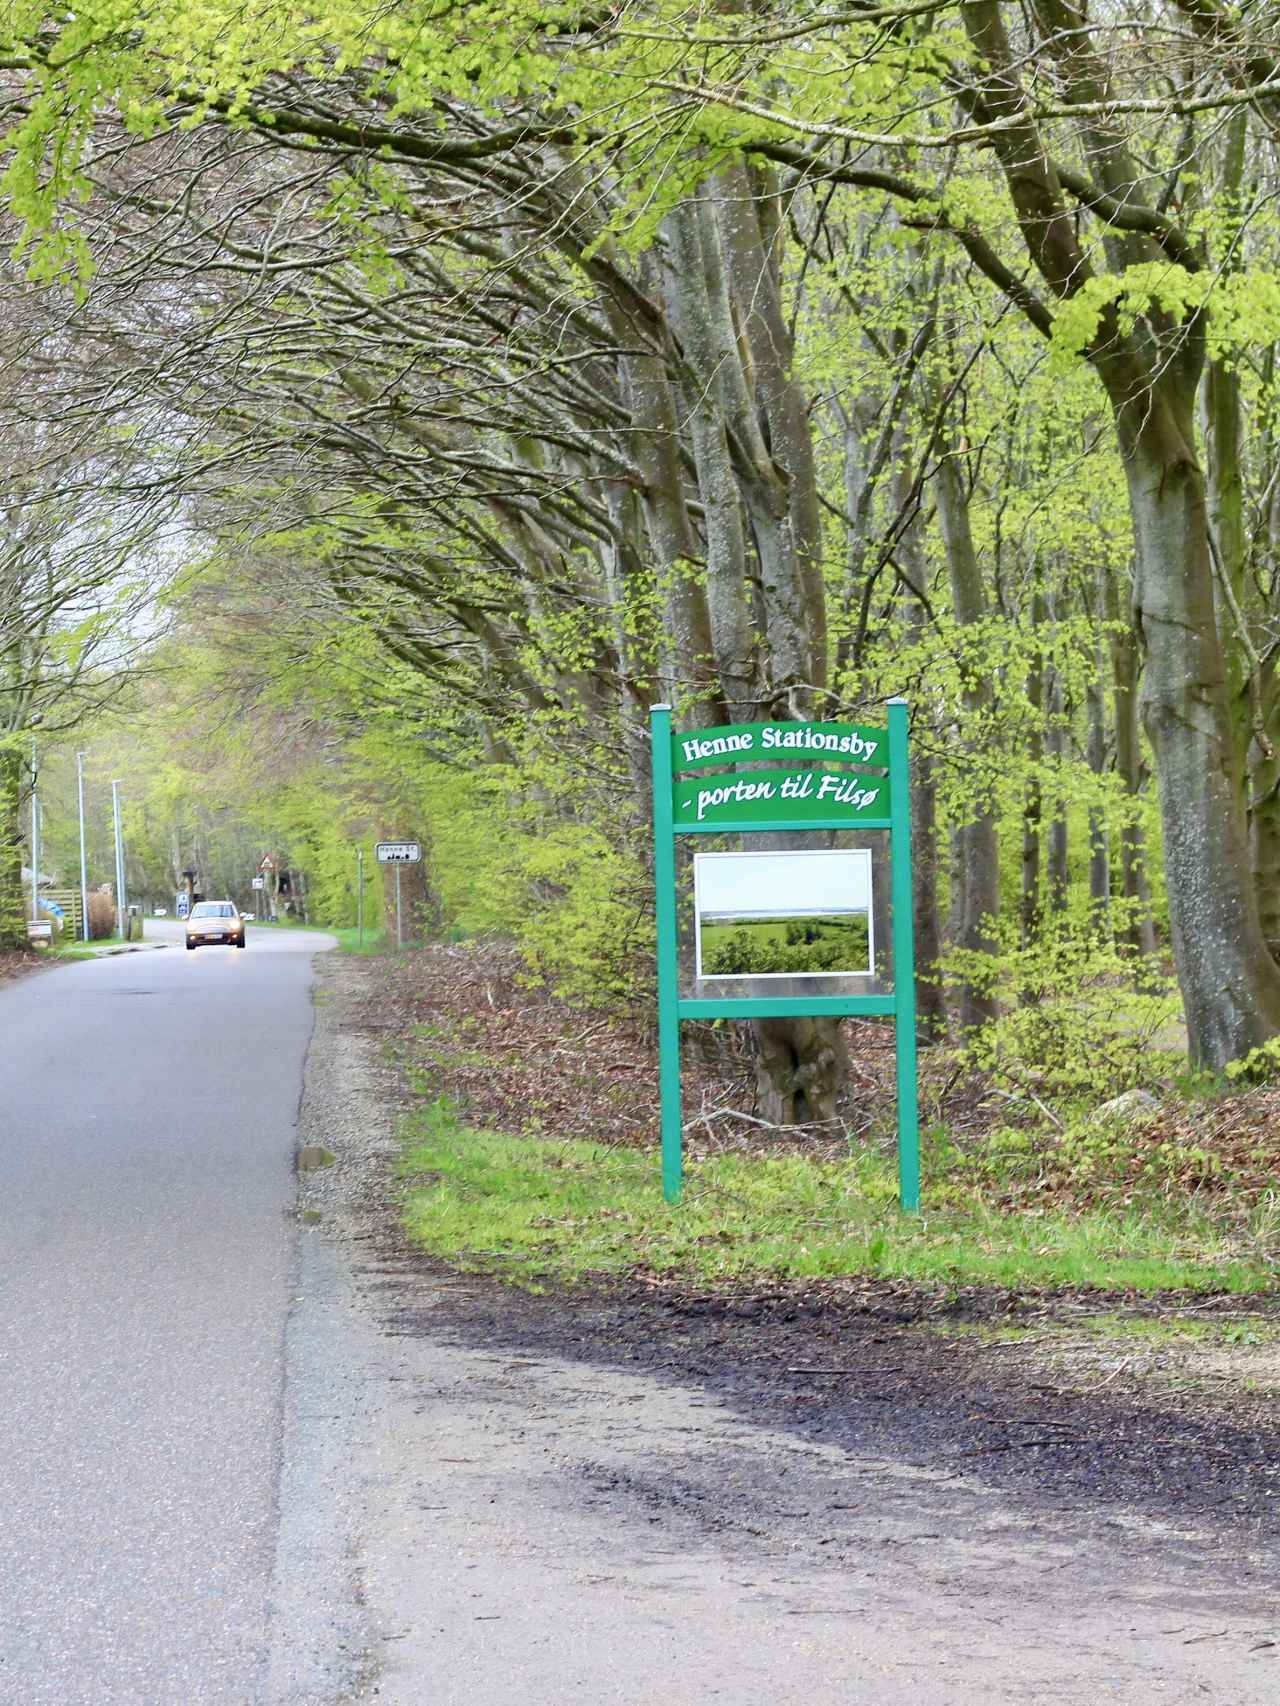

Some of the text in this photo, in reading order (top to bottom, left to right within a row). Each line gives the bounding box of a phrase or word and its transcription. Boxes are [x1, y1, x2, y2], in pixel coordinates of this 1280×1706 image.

[681, 727, 878, 762] Henne Stationsby
[697, 779, 777, 820] porten
[780, 773, 814, 798] til
[816, 775, 880, 810] Filsø
